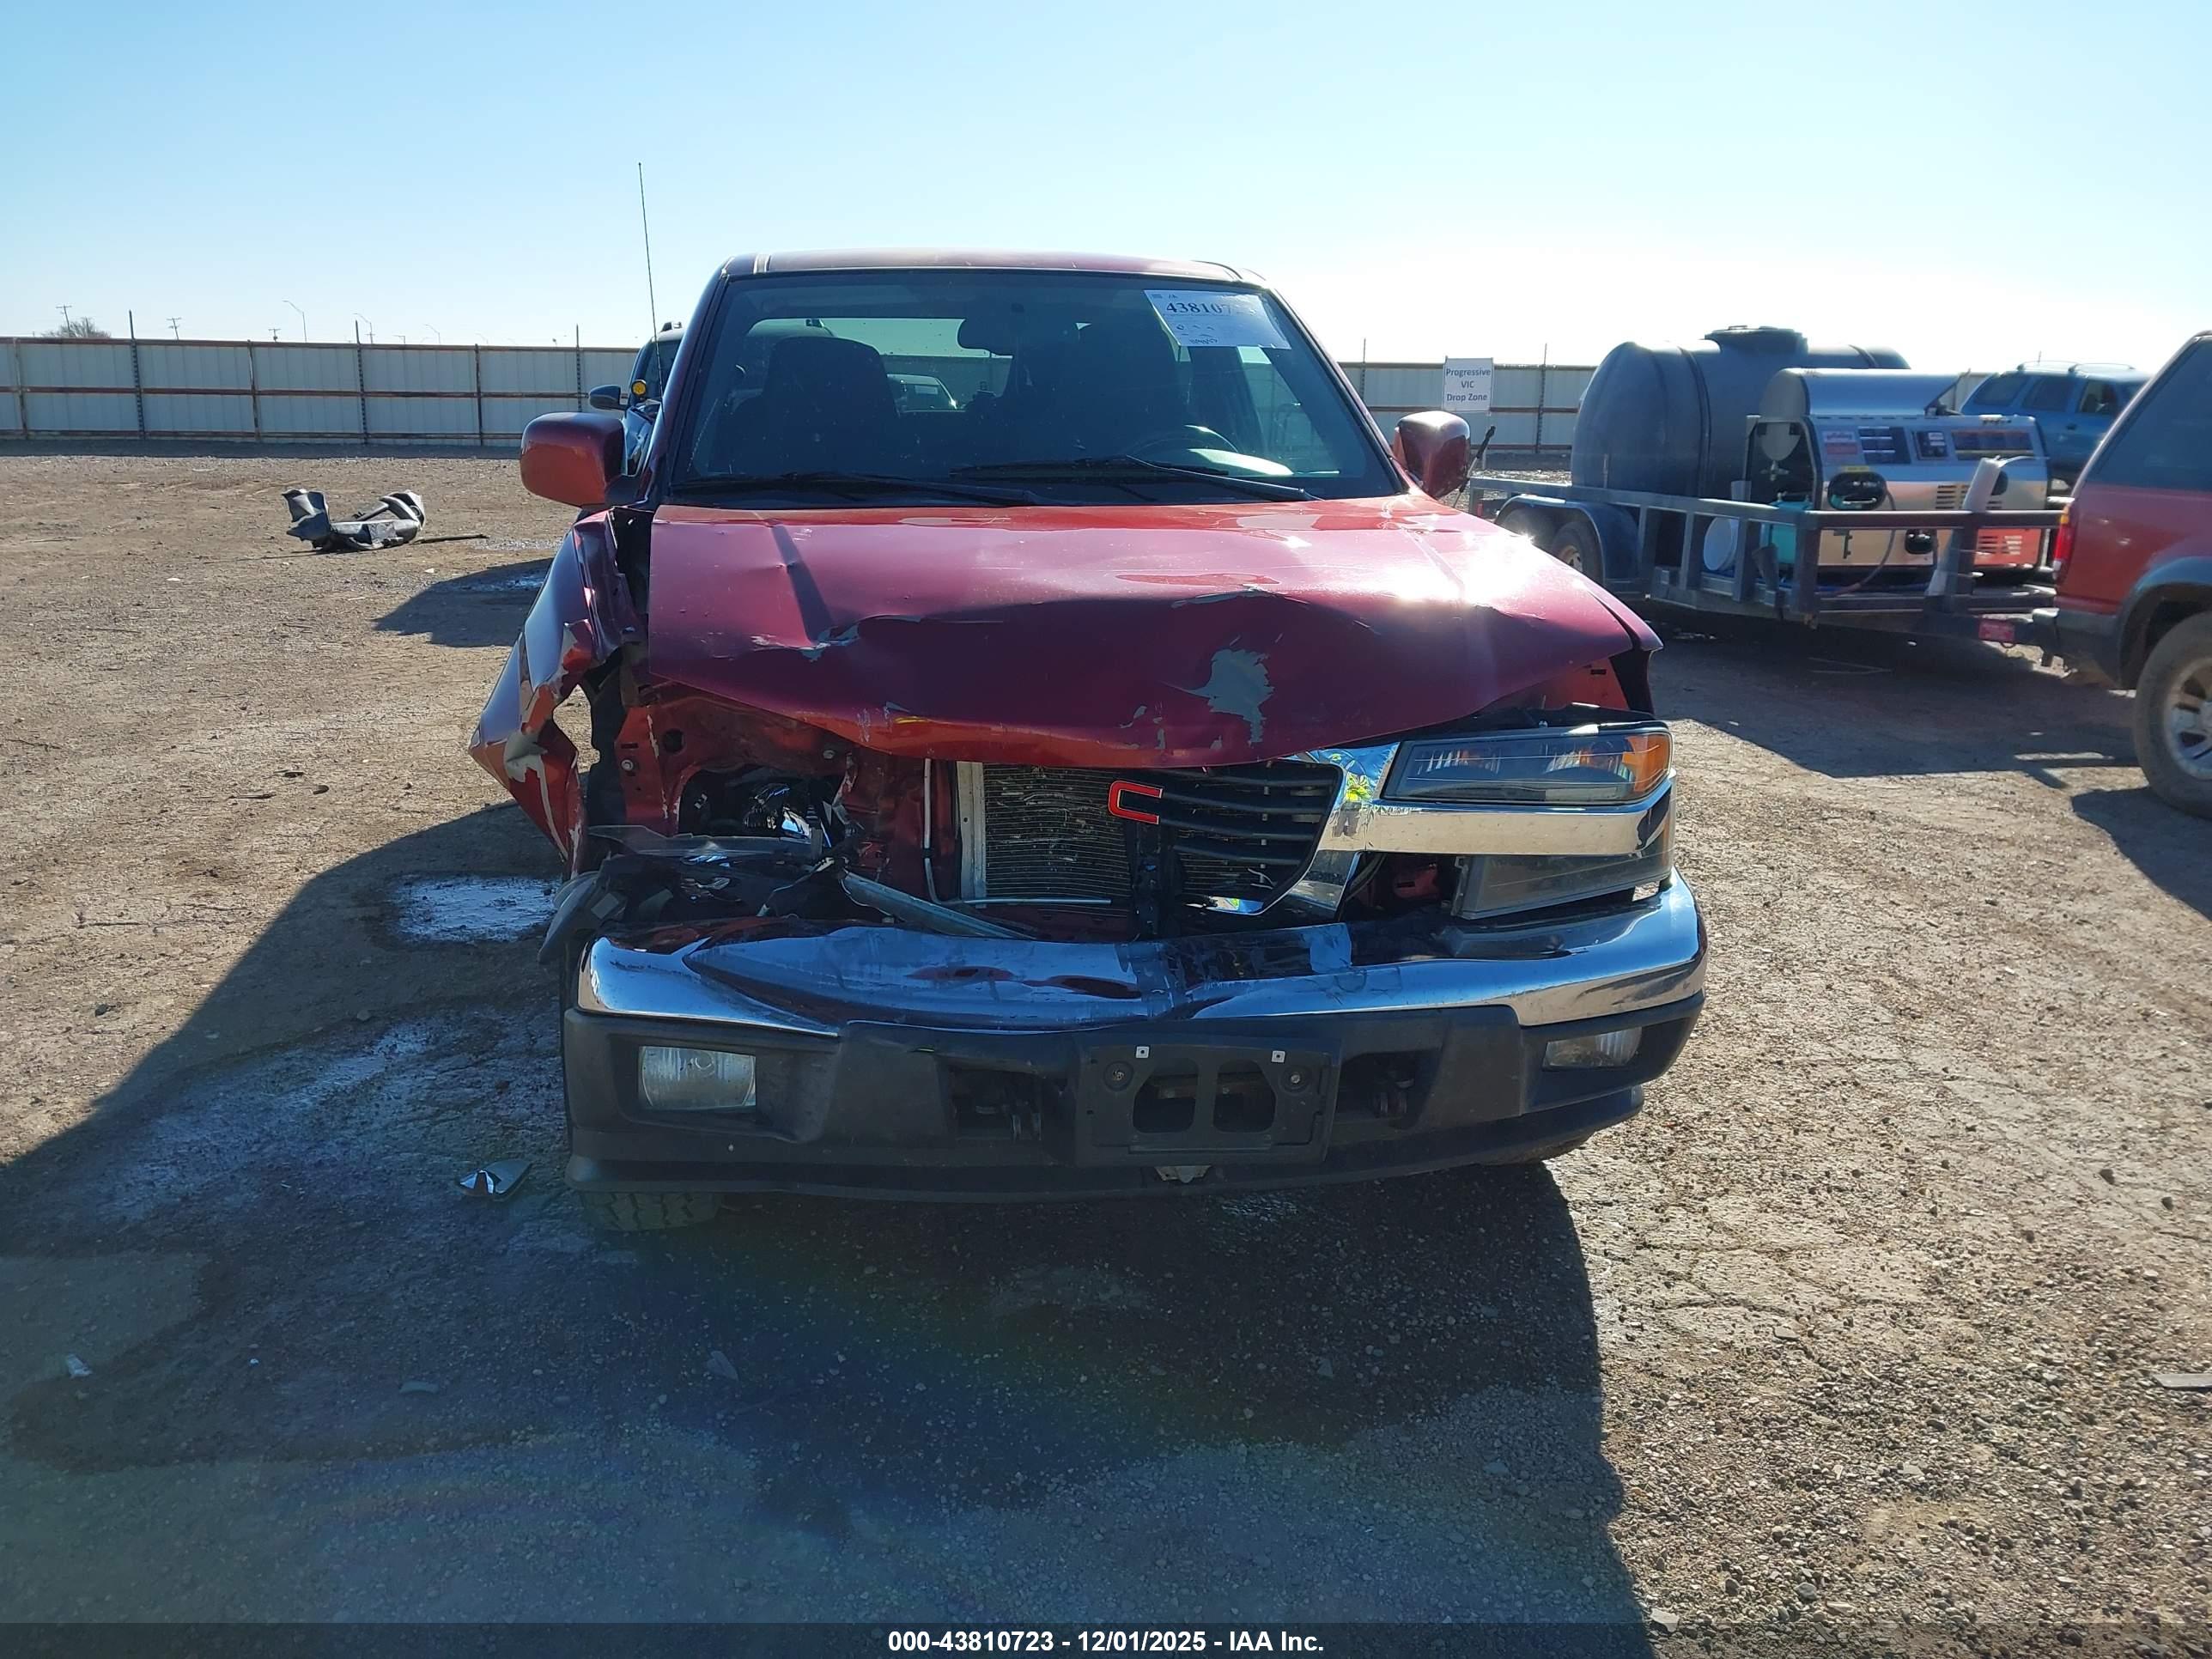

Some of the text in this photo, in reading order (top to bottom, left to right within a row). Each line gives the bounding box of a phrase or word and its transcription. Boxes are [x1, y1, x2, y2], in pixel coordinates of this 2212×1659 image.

[1166, 301, 1257, 316] 438107
[1446, 368, 1492, 378] Progressive
[1447, 393, 1467, 403] Drop
